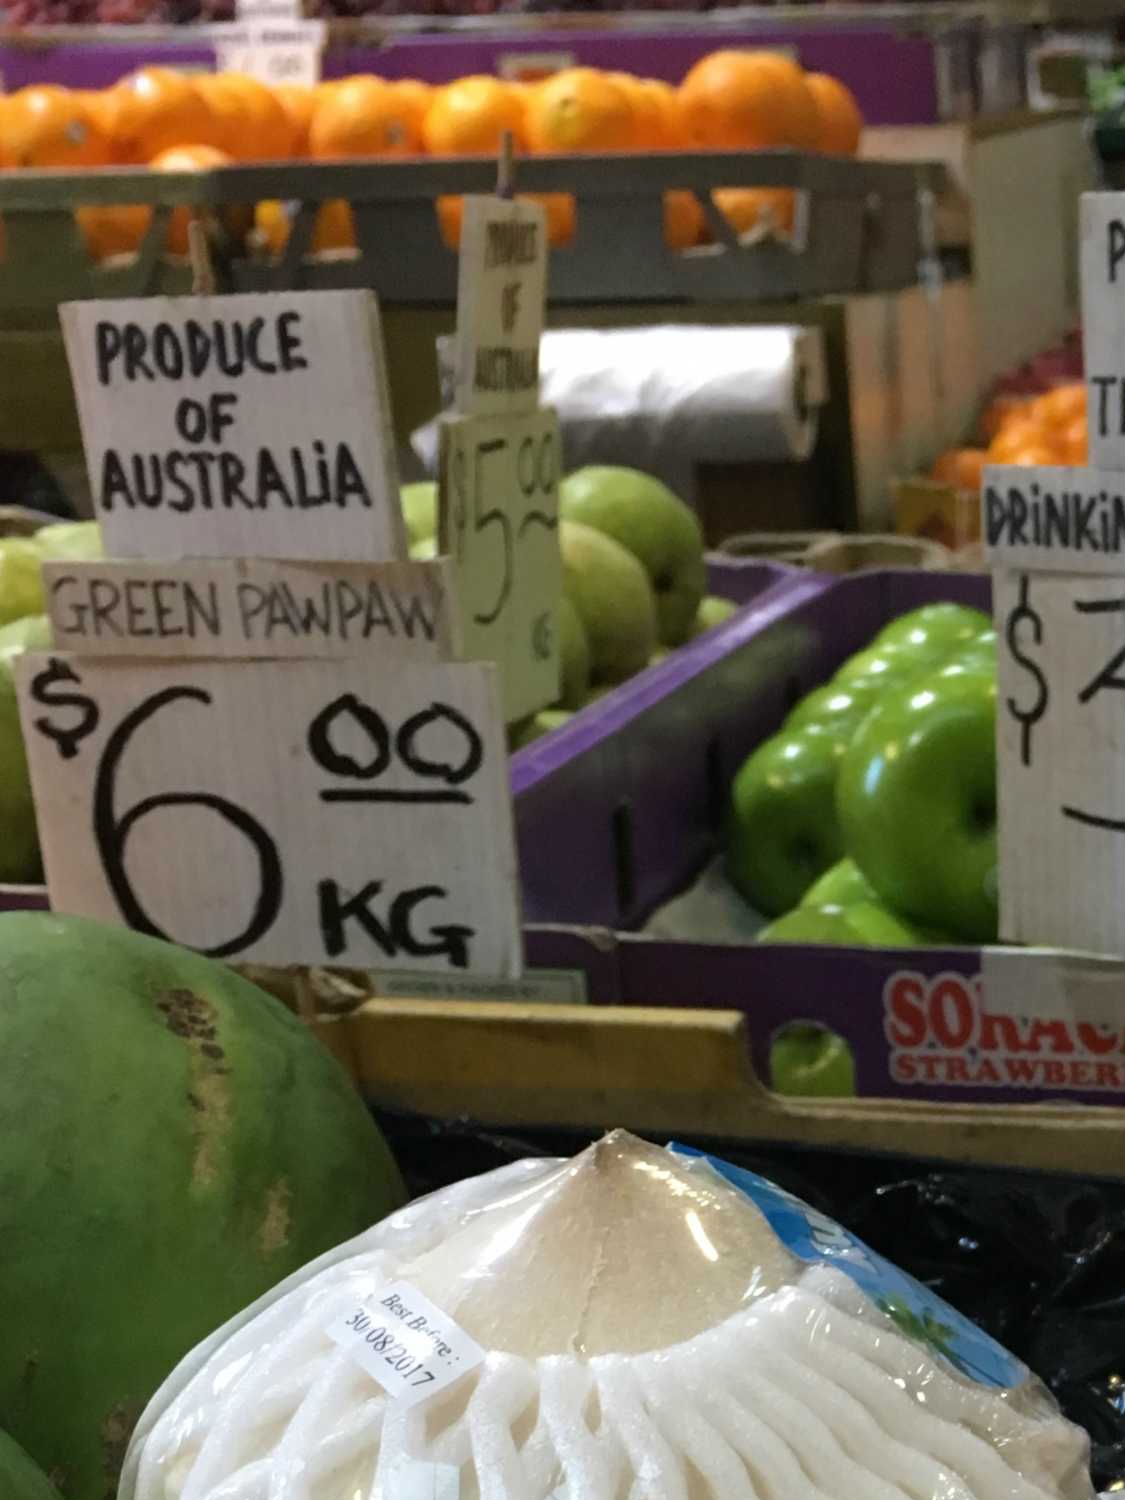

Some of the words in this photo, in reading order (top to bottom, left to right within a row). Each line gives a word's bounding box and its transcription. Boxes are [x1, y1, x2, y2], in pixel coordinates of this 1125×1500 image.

[96, 312, 308, 386] PRODUCE
[175, 394, 239, 445] OF
[51, 575, 220, 639] GREEN
[239, 578, 437, 641] PAWPAW
[318, 879, 475, 968] KG
[381, 1294, 413, 1321] Best
[345, 1307, 436, 1386] 30/08/2017
